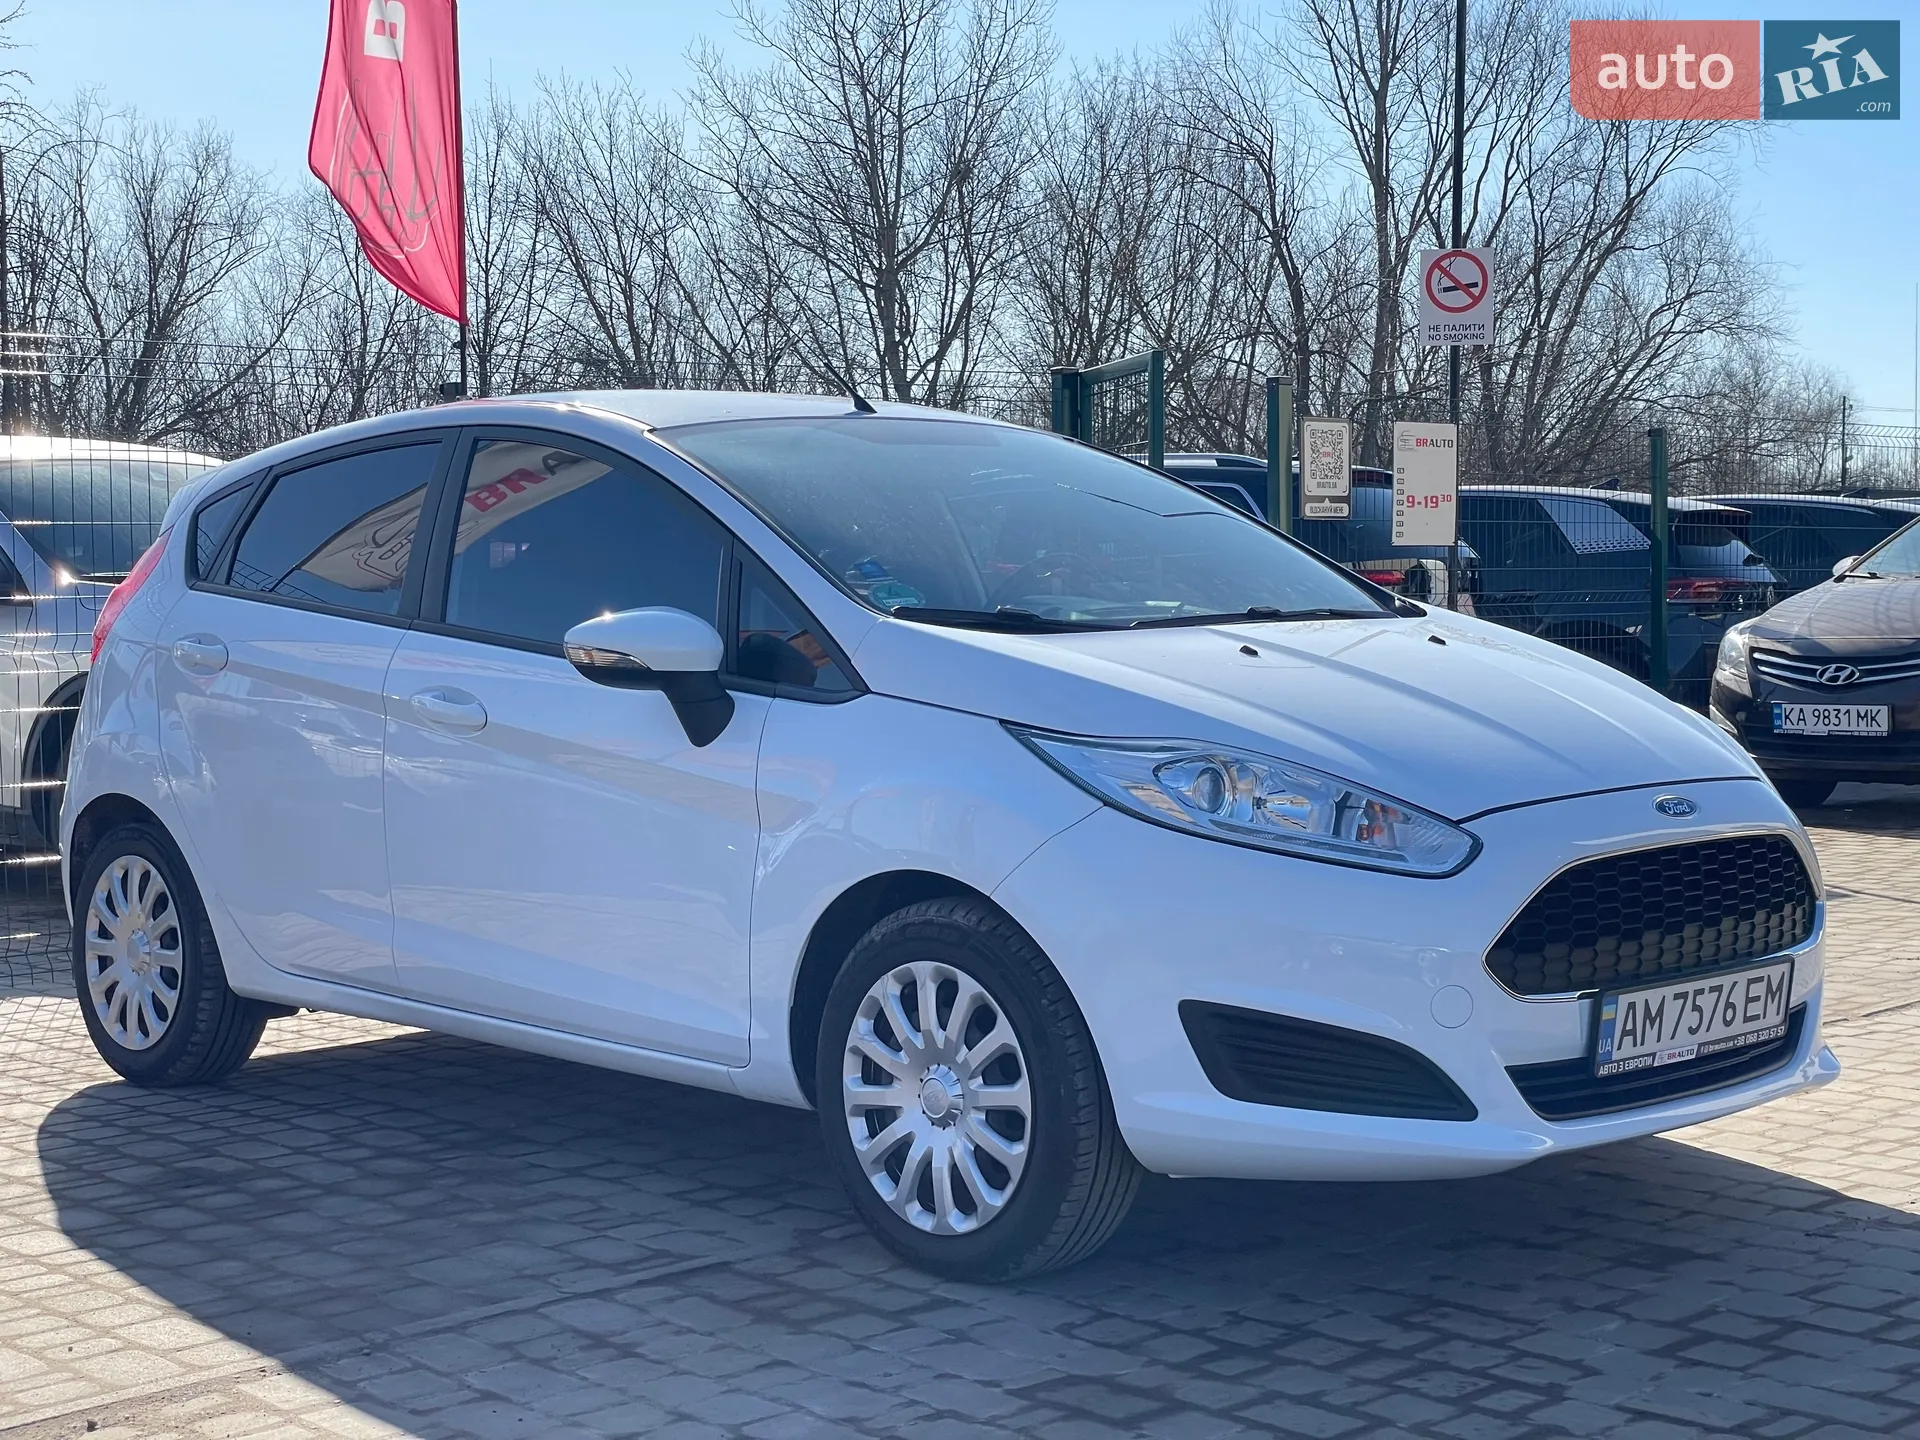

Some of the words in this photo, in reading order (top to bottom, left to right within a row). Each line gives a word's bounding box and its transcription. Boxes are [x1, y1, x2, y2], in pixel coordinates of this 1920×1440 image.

[1428, 324, 1441, 333] НЕ
[1443, 323, 1485, 333] ПАЛИТИ
[1428, 333, 1441, 341] NO
[1443, 332, 1485, 341] SMOKING
[1415, 438, 1454, 448] BRAUTO
[1784, 708, 1807, 727] KA
[1812, 708, 1852, 727] 9831
[1856, 708, 1882, 728] MK
[1663, 800, 1691, 814] Ford
[1617, 995, 1666, 1050] AM
[1670, 980, 1739, 1040] 7576
[1742, 971, 1786, 1024] EM
[1598, 1037, 1612, 1054] UA
[1667, 1048, 1695, 1061] BRAUTO
[1598, 1063, 1618, 1076] АВТО
[1624, 1055, 1653, 1070] ЕВРОПИ
